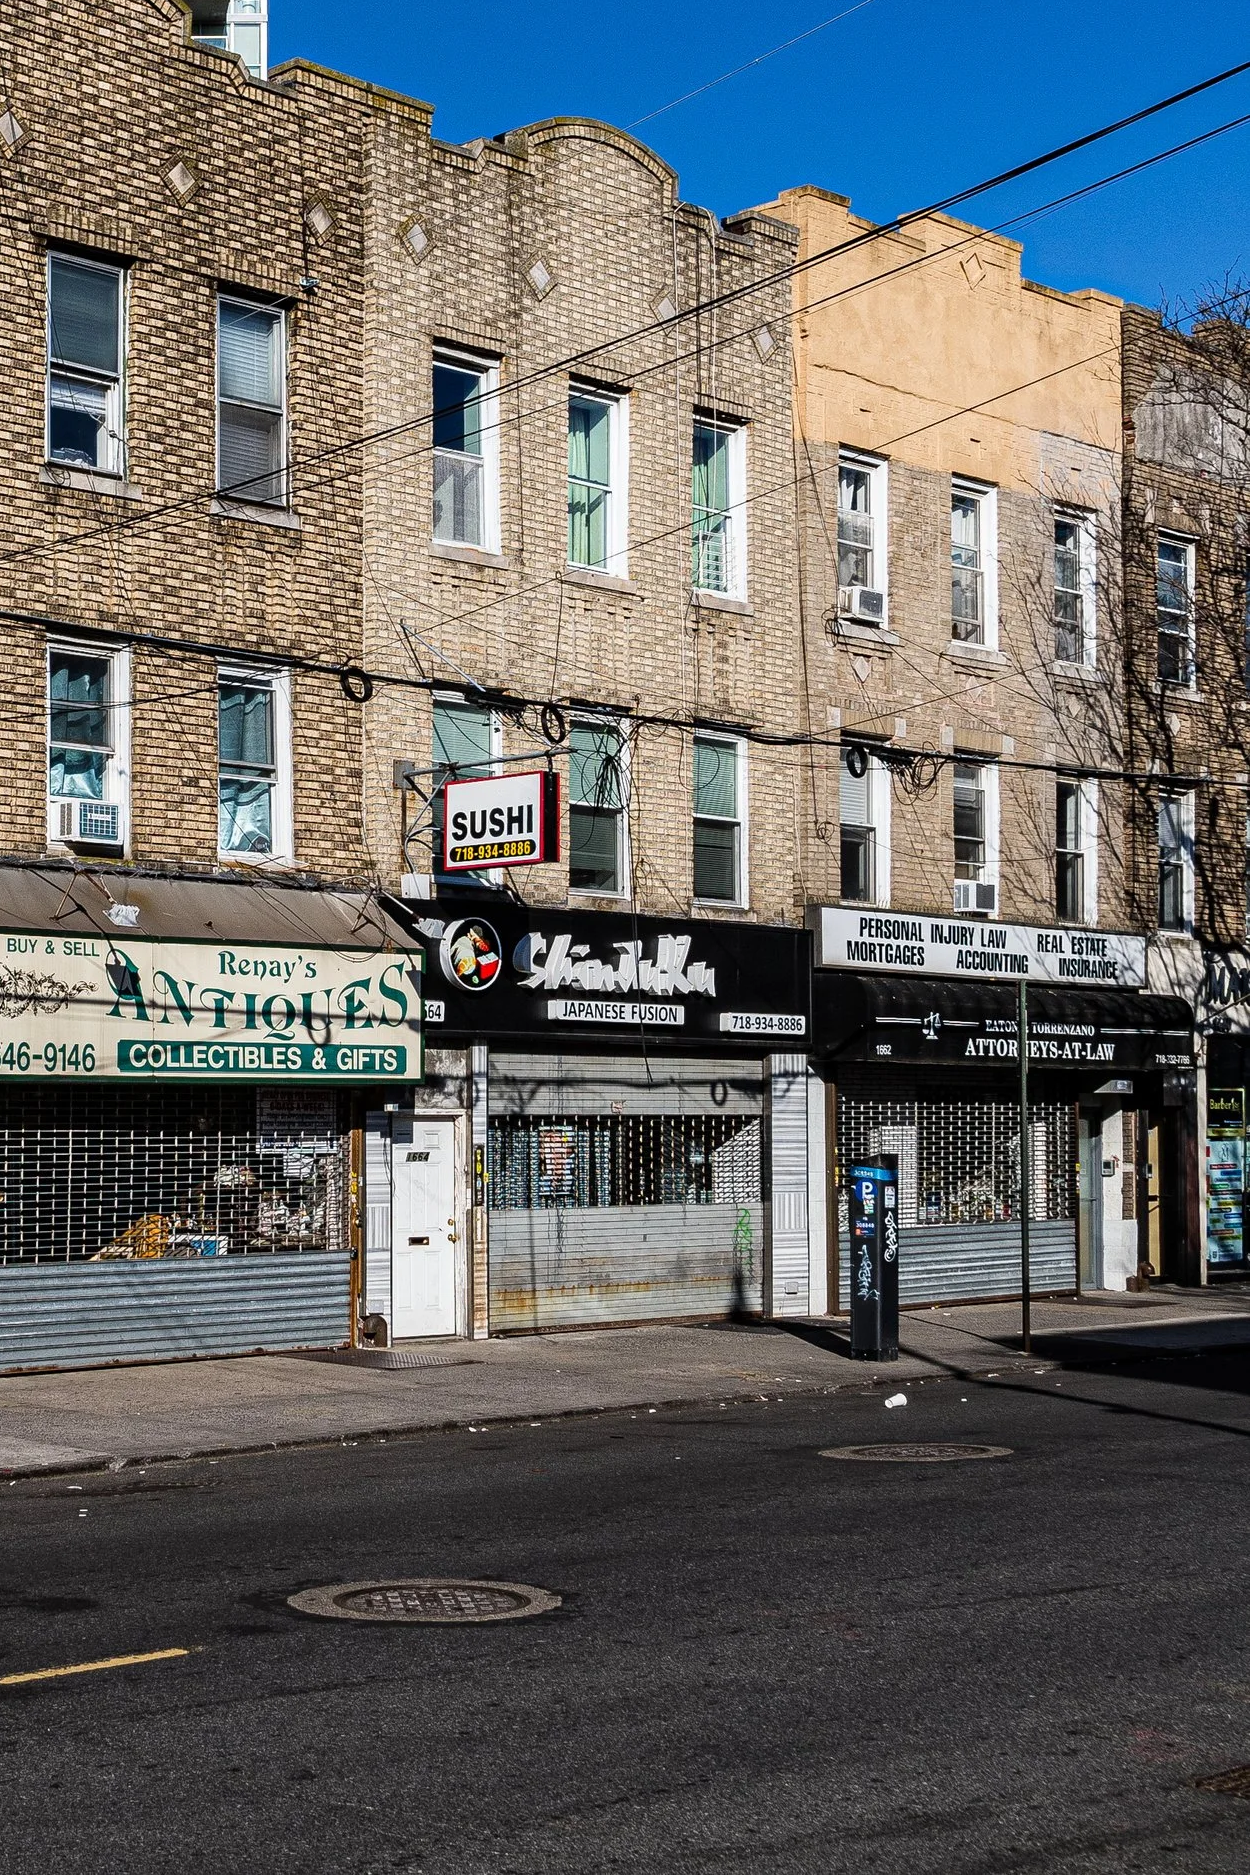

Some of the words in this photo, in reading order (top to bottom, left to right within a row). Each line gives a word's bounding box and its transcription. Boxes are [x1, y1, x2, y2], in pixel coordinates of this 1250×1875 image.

[452, 804, 533, 841] SUSHI
[455, 841, 530, 862] 718-934-8886
[7, 938, 38, 954] BUY
[45, 941, 56, 955] &
[63, 941, 100, 957] SELL
[859, 917, 925, 942] PERSONAL
[930, 924, 975, 946] INJURY
[980, 928, 1007, 949] LAW
[1037, 933, 1065, 954] REAL
[1071, 936, 1107, 957] ESTATE
[218, 950, 317, 983] Renay's
[846, 940, 925, 967] MORTGAGES
[956, 949, 1028, 974] ACCOUNTING
[1058, 958, 1118, 980] INSURANCE
[105, 948, 409, 1041] ANTIQUES
[562, 1002, 626, 1020] JAPANESE
[631, 1005, 678, 1022] FUSION
[732, 1016, 803, 1031] 718-934-8886
[1031, 1022, 1095, 1036] TORRENZANO
[129, 1043, 302, 1070] COLLECTIBLES
[311, 1049, 327, 1070] &
[336, 1048, 398, 1070] GIFTS
[876, 1044, 892, 1055] 1662
[406, 1152, 430, 1162] 1664
